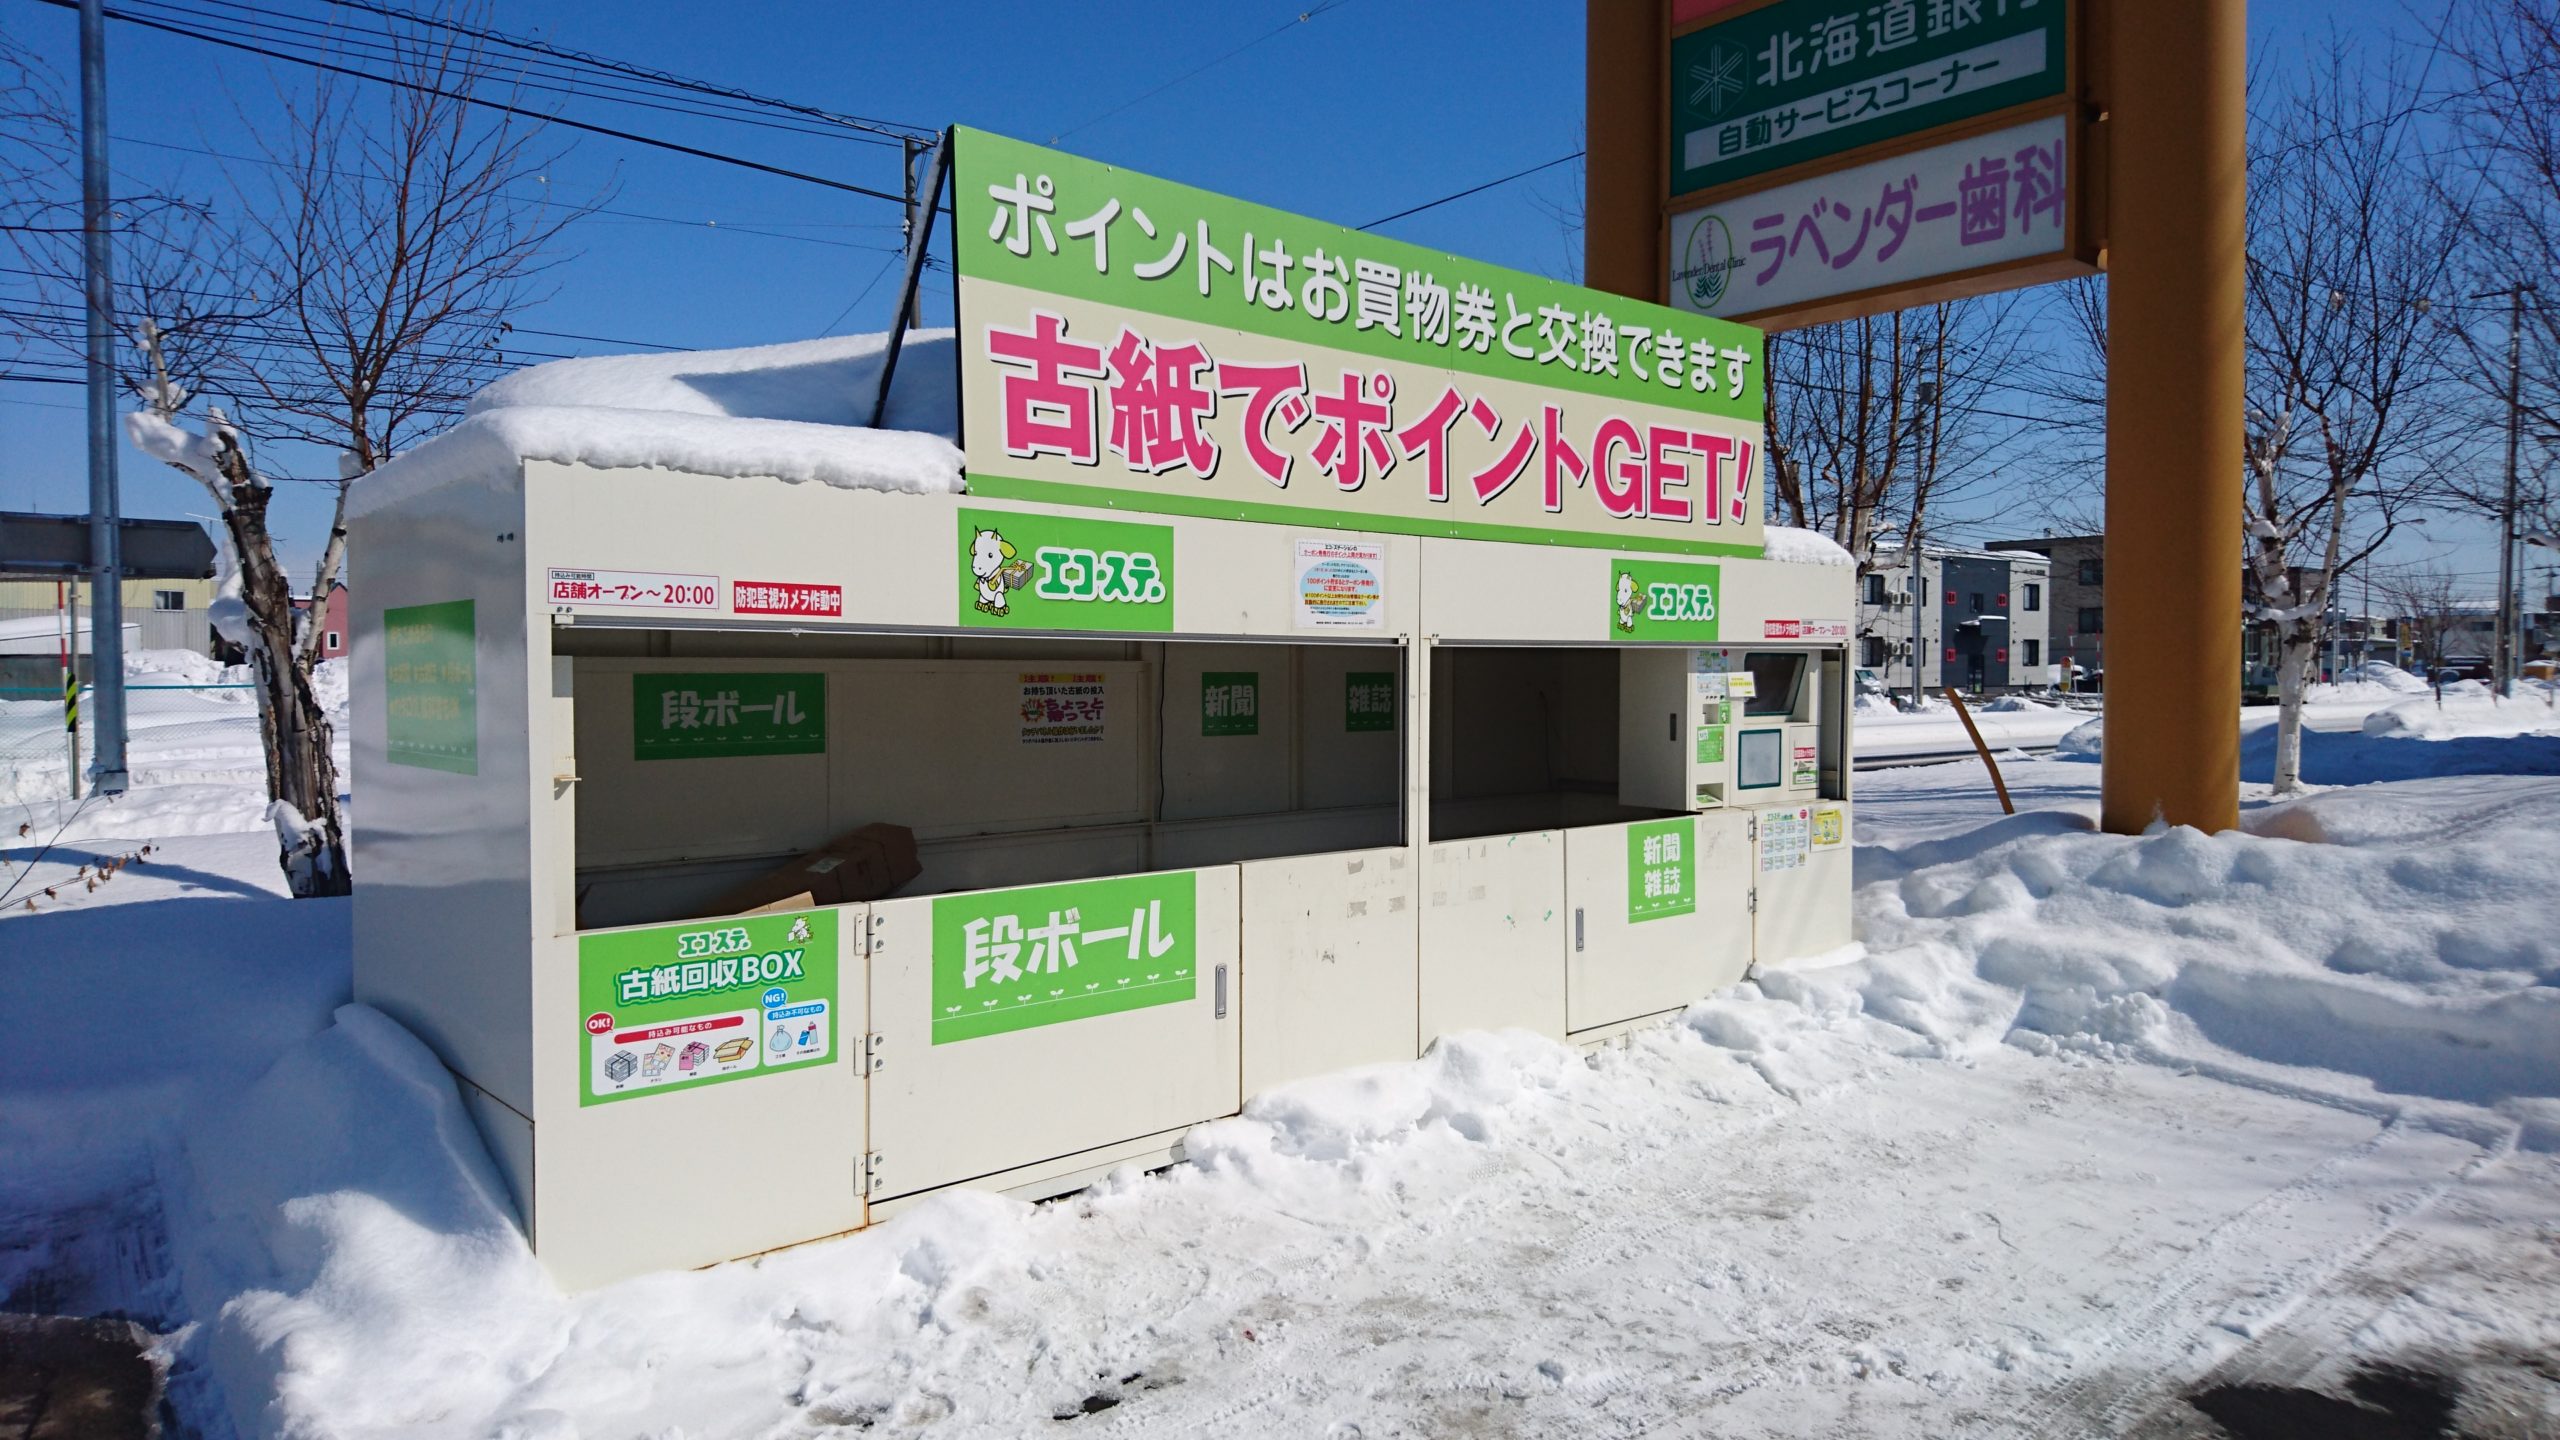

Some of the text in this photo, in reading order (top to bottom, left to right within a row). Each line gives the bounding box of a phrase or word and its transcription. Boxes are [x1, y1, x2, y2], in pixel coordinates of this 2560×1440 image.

[1718, 59, 2000, 156] 自動サービスコーナー
[1750, 138, 2065, 286] ラベンダー歯科
[1672, 255, 1747, 282] Lavender Dental Clinic
[987, 172, 1753, 401] ポイントはお買物券と交換できます
[986, 310, 1754, 526] 古紙でポイントGET!
[735, 586, 841, 611] 防犯監視カメラ作動中
[1023, 686, 1104, 696] お持ち頂いた古紙の投入
[1045, 698, 1104, 710] ちょっと
[1205, 685, 1255, 717] 新聞
[1349, 684, 1392, 713] 雑誌
[661, 689, 806, 730] 段ボール
[1046, 709, 1101, 722] 待って!
[1643, 832, 1681, 865] 新聞
[1644, 866, 1681, 898] 雑誌
[962, 898, 1175, 989] 段ボール
[620, 950, 803, 1000] 古紙回収BOX
[765, 993, 785, 1003] NG!
[772, 1005, 822, 1020] 持込み不可なもの
[588, 1018, 612, 1029] OK!
[648, 1021, 713, 1039] 持込み可能なもの
